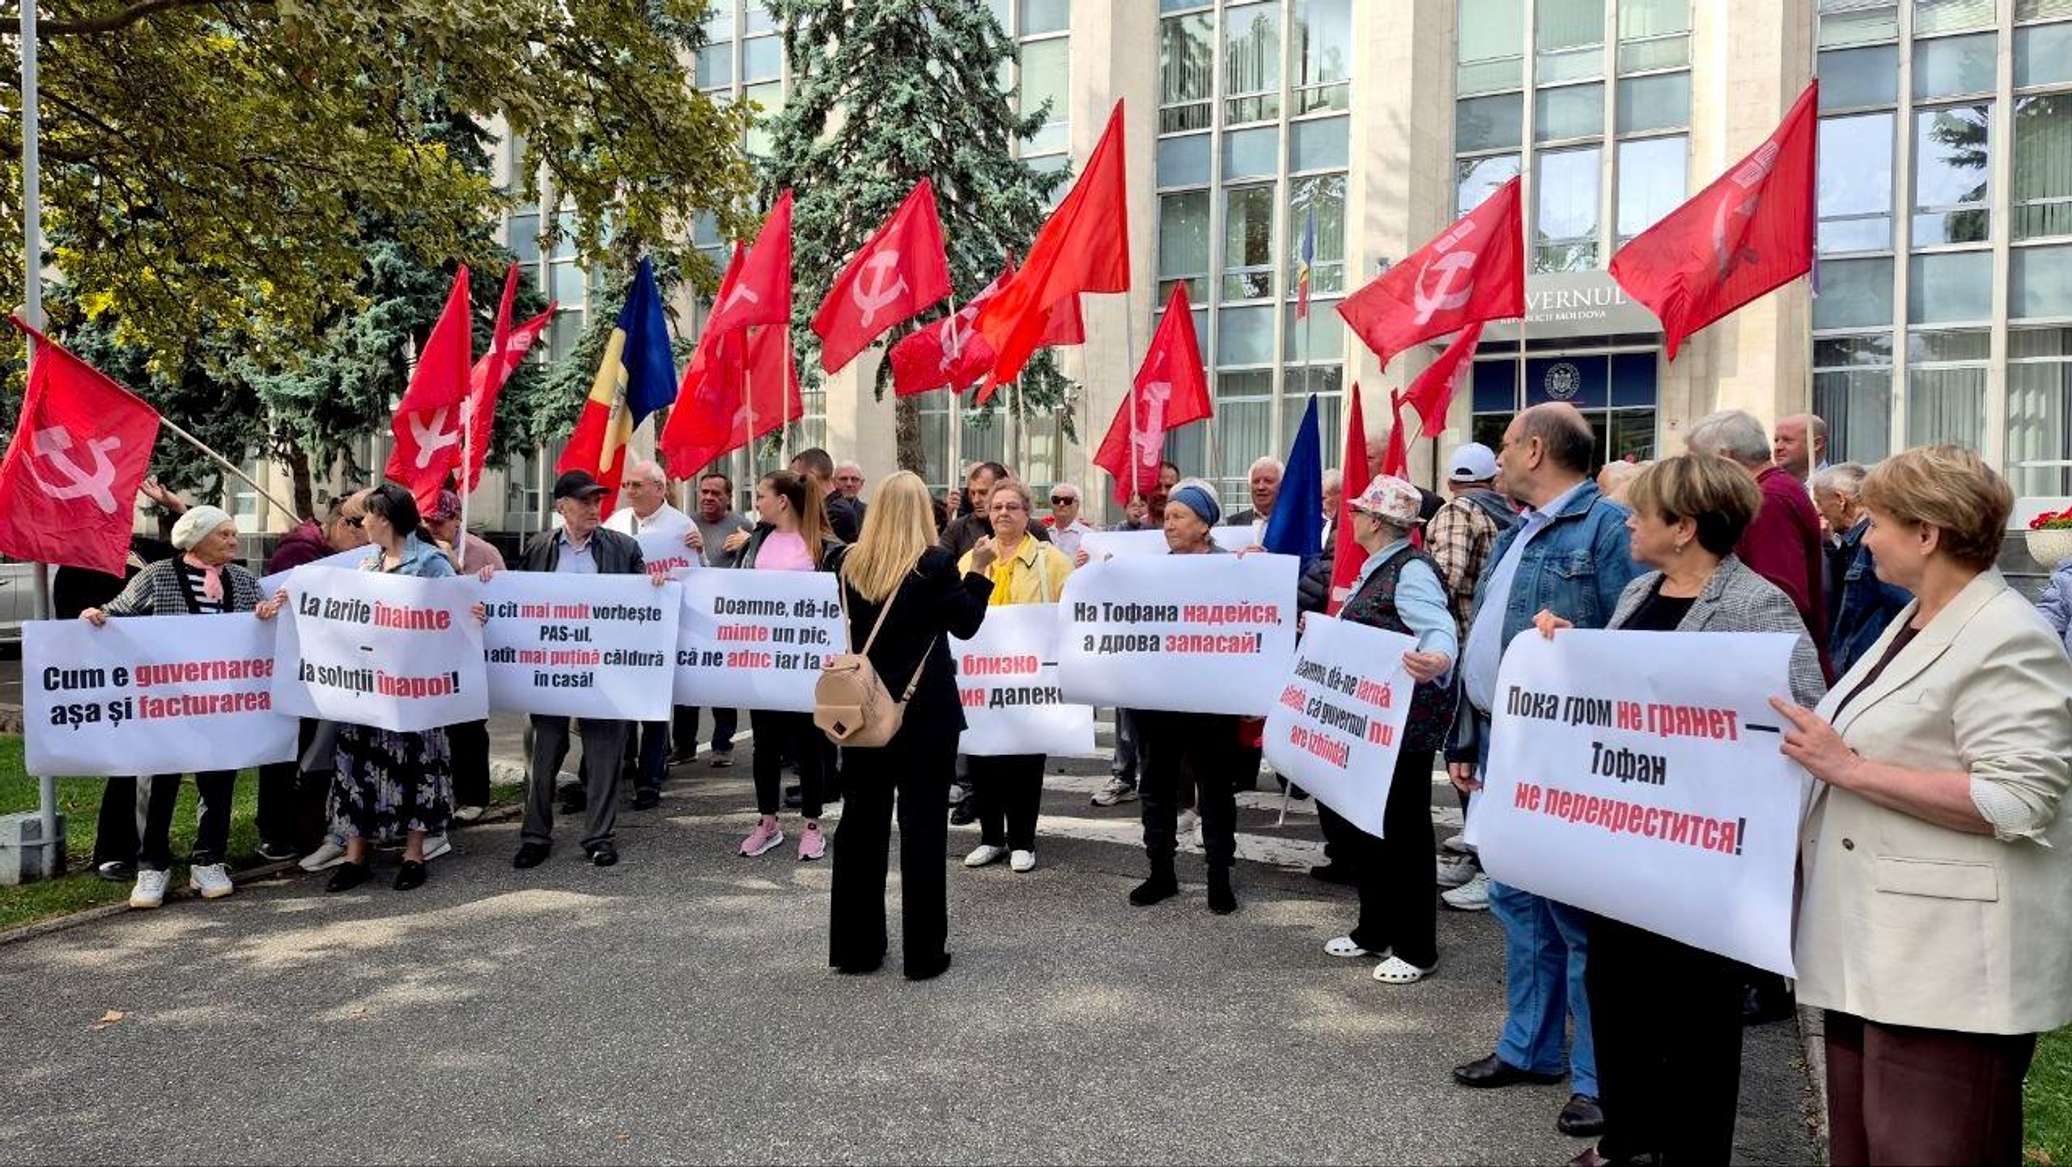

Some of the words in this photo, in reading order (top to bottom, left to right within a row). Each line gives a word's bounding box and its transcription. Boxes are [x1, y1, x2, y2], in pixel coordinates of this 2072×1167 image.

[1523, 286, 1627, 310] VERNUL
[299, 592, 320, 617] La
[323, 598, 371, 624] tarife
[374, 600, 452, 630] înainte
[498, 601, 519, 619] cît
[521, 602, 550, 619] mai
[553, 602, 590, 620] mult
[593, 604, 662, 625] vorbește
[714, 596, 790, 618] Doamne,
[793, 599, 840, 619] dă-le
[1074, 602, 1097, 623] На
[1102, 602, 1178, 625] Тофана
[1183, 601, 1282, 626] надейся,
[539, 625, 593, 643] PAS-ul,
[717, 623, 769, 642] minte
[772, 627, 795, 644] un
[798, 626, 831, 646] pic,
[1083, 634, 1095, 652] а
[1098, 633, 1161, 655] дрова
[1165, 632, 1263, 654] запасай!
[491, 646, 516, 664] atît
[519, 648, 547, 665] mai
[550, 649, 600, 669] puțină
[603, 650, 664, 667] căldură
[676, 647, 699, 667] că
[701, 650, 724, 667] ne
[727, 650, 772, 669] aduc
[774, 651, 800, 670] iar
[803, 652, 821, 670] la
[962, 653, 1039, 676] близко
[43, 666, 106, 691] Cum
[111, 666, 130, 687] e
[134, 657, 275, 688] guvernarea
[298, 658, 316, 683] la
[318, 665, 374, 697] soluții
[376, 670, 460, 699] înapoi!
[534, 670, 549, 687] în
[552, 671, 594, 688] casă!
[1327, 666, 1358, 696] dă-ne
[1356, 675, 1392, 709] iarnă
[51, 703, 102, 731] așa
[108, 696, 133, 728] și
[138, 690, 272, 719] facturarea
[1306, 696, 1323, 719] că
[1320, 702, 1369, 740] guvernul
[1368, 721, 1393, 747] nu
[1507, 685, 1559, 721] Пока
[1562, 695, 1612, 727] гром
[1616, 700, 1643, 732] не
[1647, 703, 1738, 741] грянет
[1290, 724, 1308, 748] are
[1591, 741, 1667, 785] Тофан
[1514, 782, 1541, 812] не
[1543, 785, 1747, 856] перекрестится!
